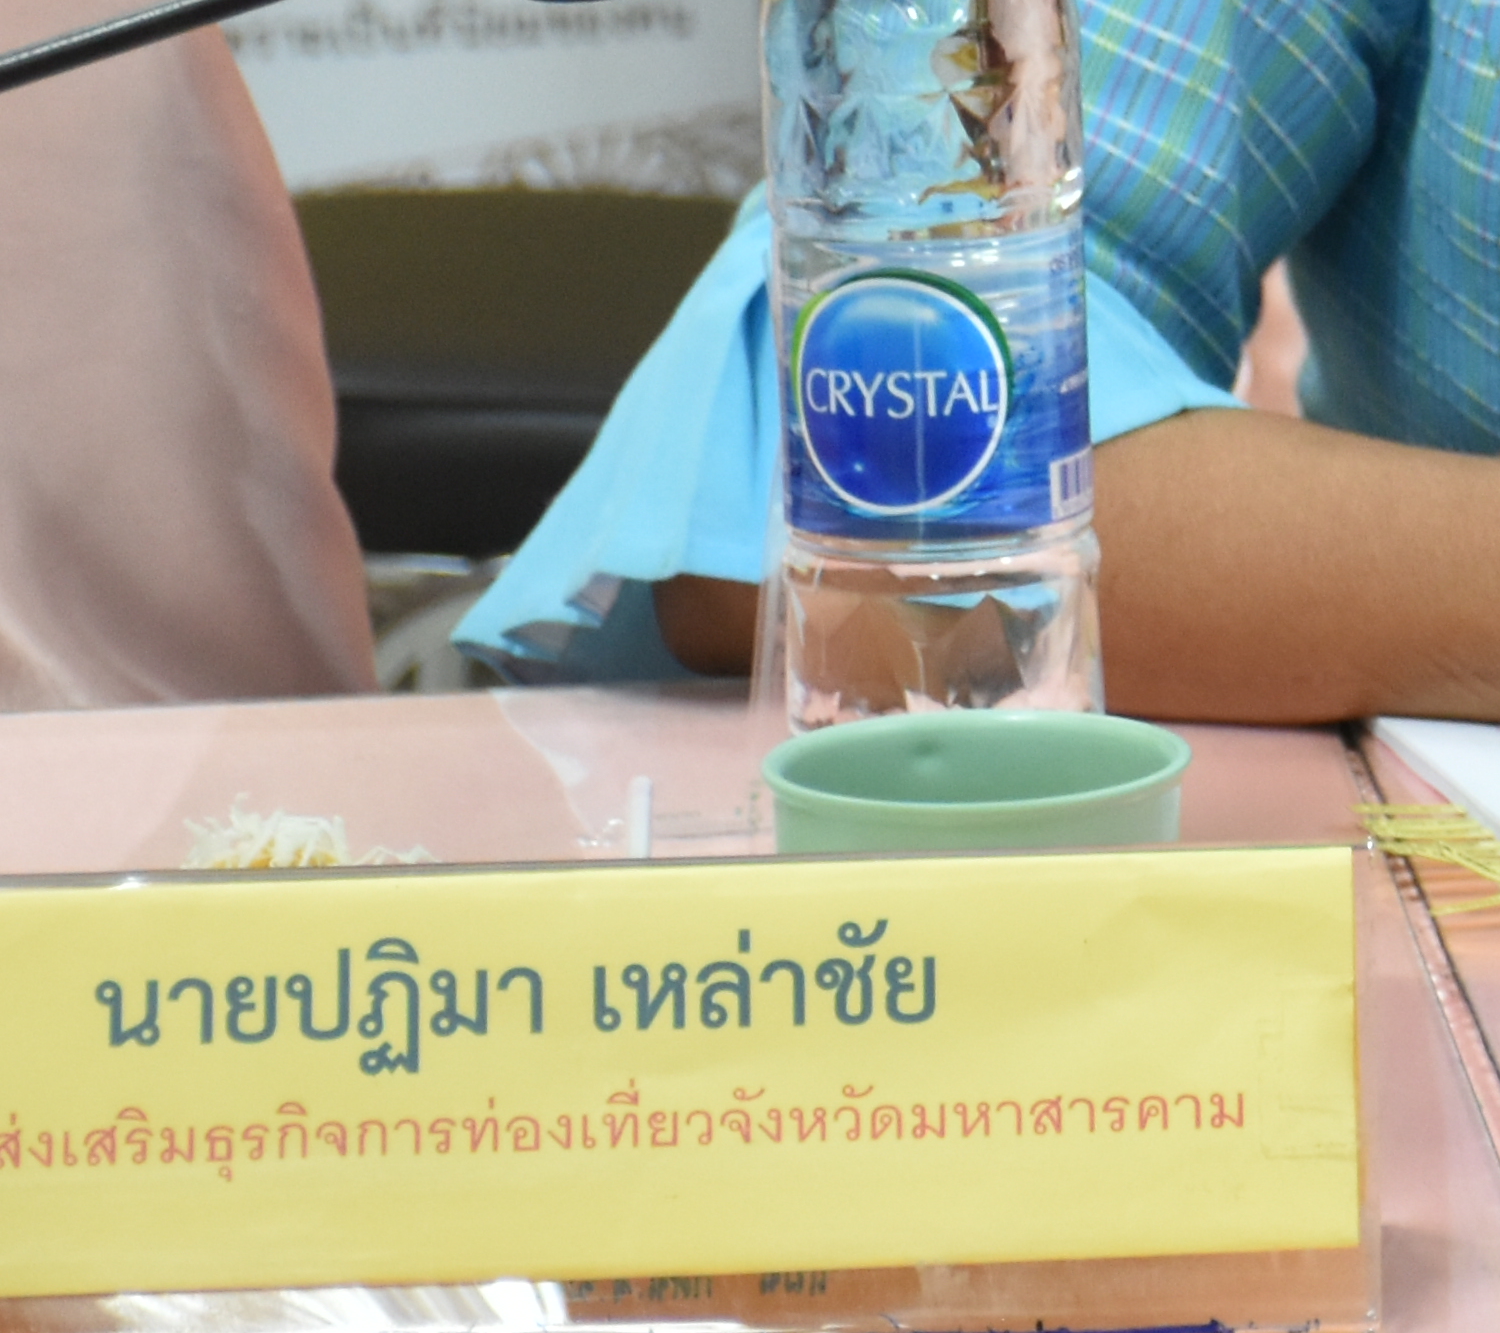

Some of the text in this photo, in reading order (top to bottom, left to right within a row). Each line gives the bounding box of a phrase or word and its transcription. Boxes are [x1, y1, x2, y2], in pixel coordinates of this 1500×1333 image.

[805, 368, 999, 418] CRYSTAL
[95, 919, 938, 1075] นายปฏิมา เหล่าชัย
